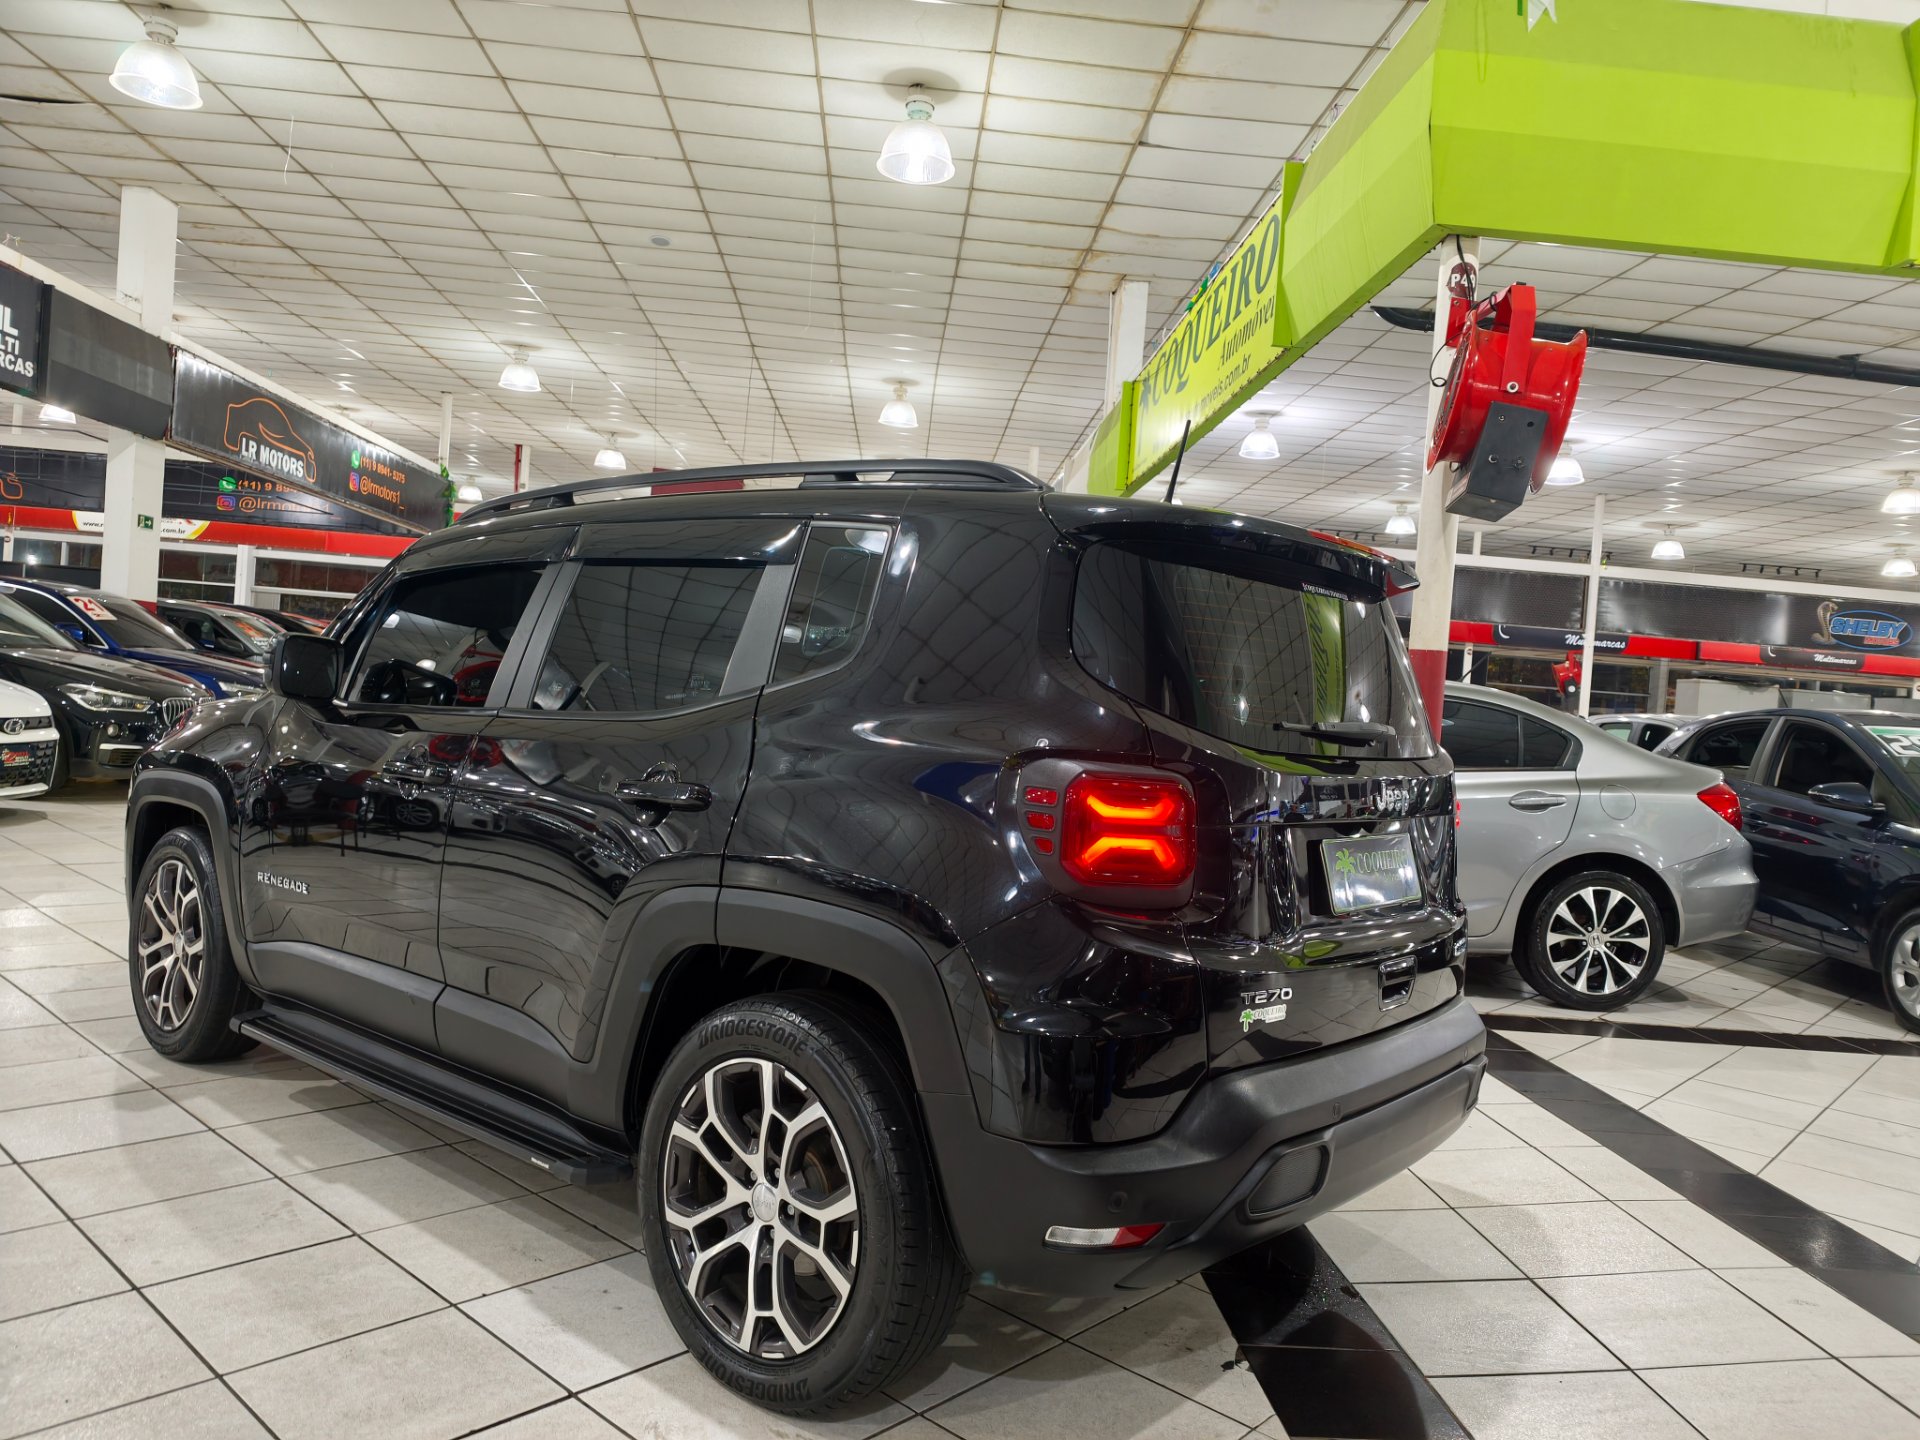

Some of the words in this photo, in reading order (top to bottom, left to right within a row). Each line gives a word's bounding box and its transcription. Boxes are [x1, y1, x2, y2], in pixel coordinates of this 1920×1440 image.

[1152, 214, 1280, 406] COQUEIRO
[241, 437, 258, 460] LR
[259, 444, 304, 478] MOTORS
[238, 480, 261, 492] (11)
[264, 483, 272, 492] 9
[1830, 616, 1908, 639] SHELBY
[1376, 780, 1409, 816] Jeep
[257, 871, 309, 895] RENEGADE
[1240, 987, 1292, 1005] T270
[698, 1018, 809, 1057] BRIDGESTONE
